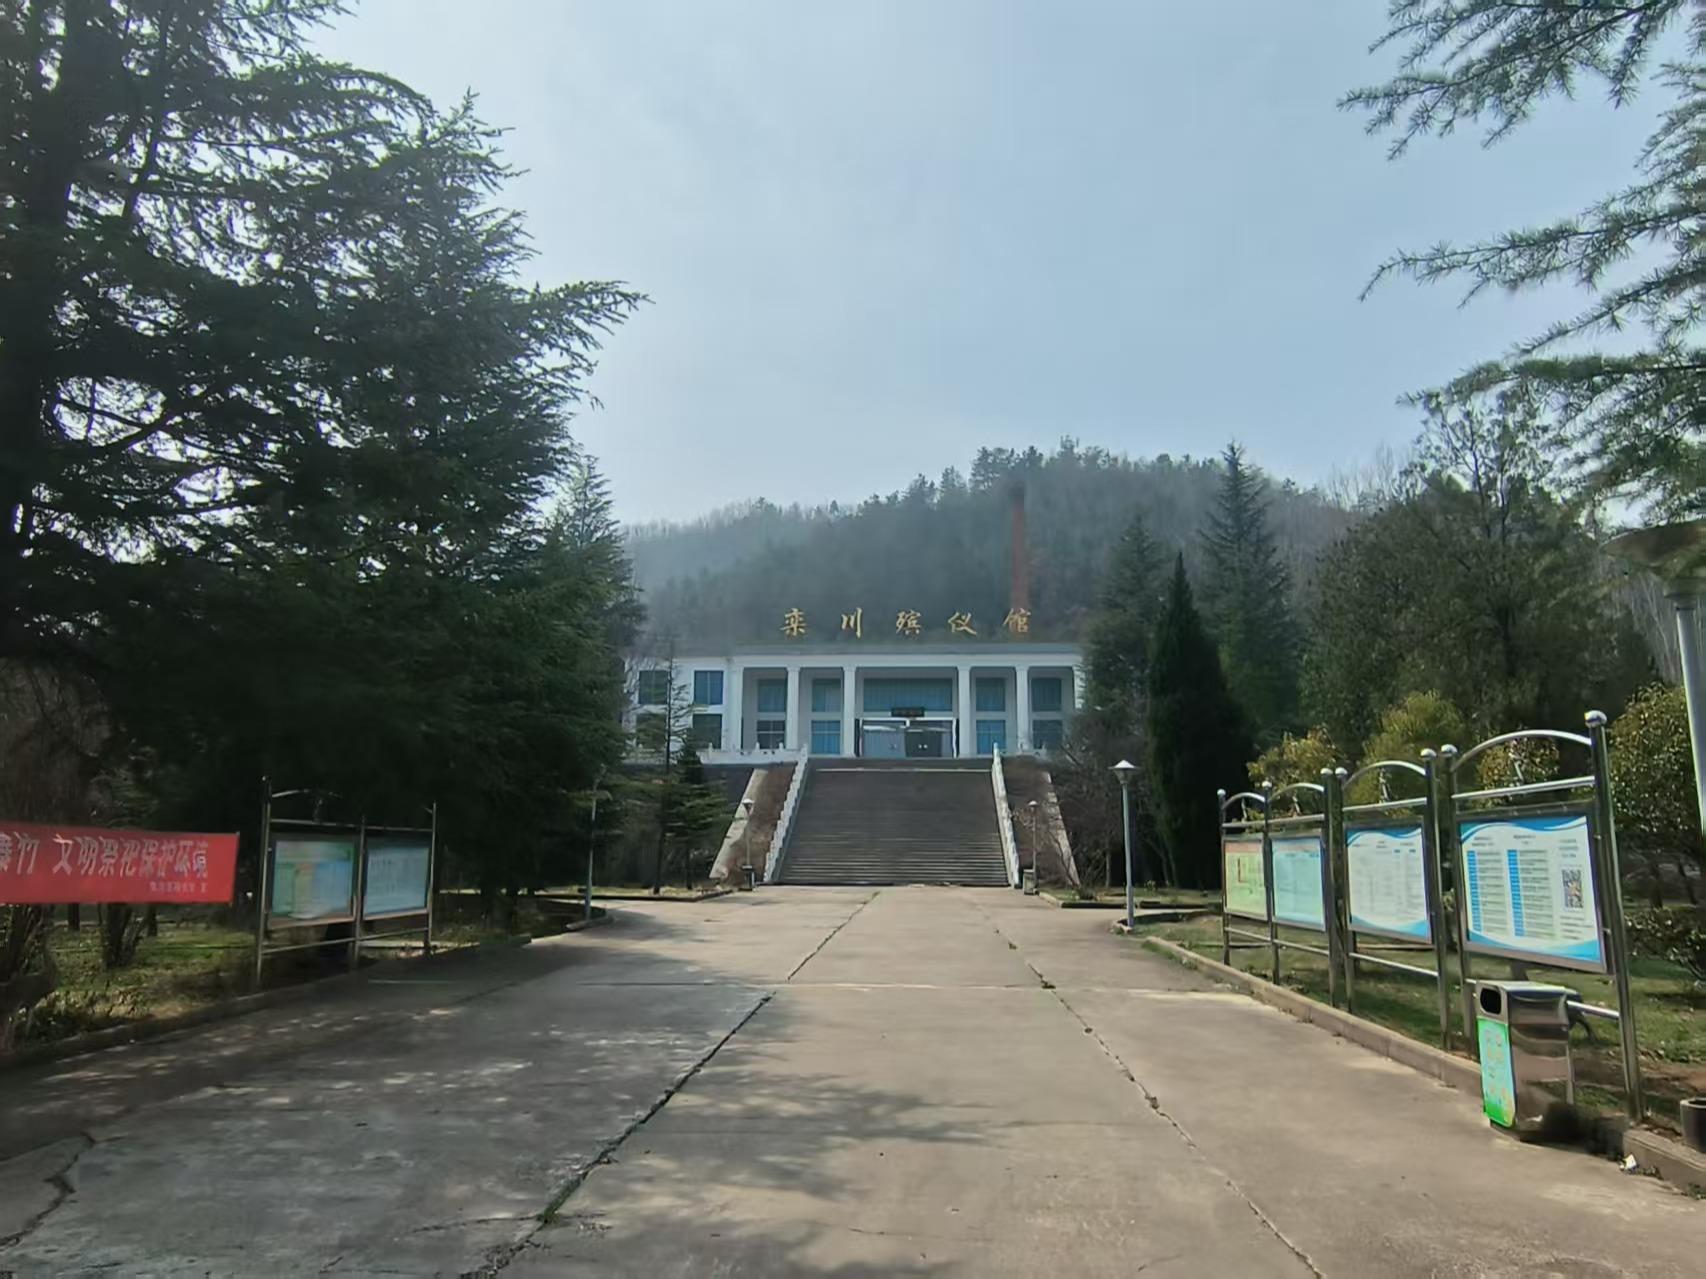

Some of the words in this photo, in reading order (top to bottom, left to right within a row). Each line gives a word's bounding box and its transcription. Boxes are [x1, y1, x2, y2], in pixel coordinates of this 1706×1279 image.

[780, 607, 1031, 639] 栾川殡仪馆
